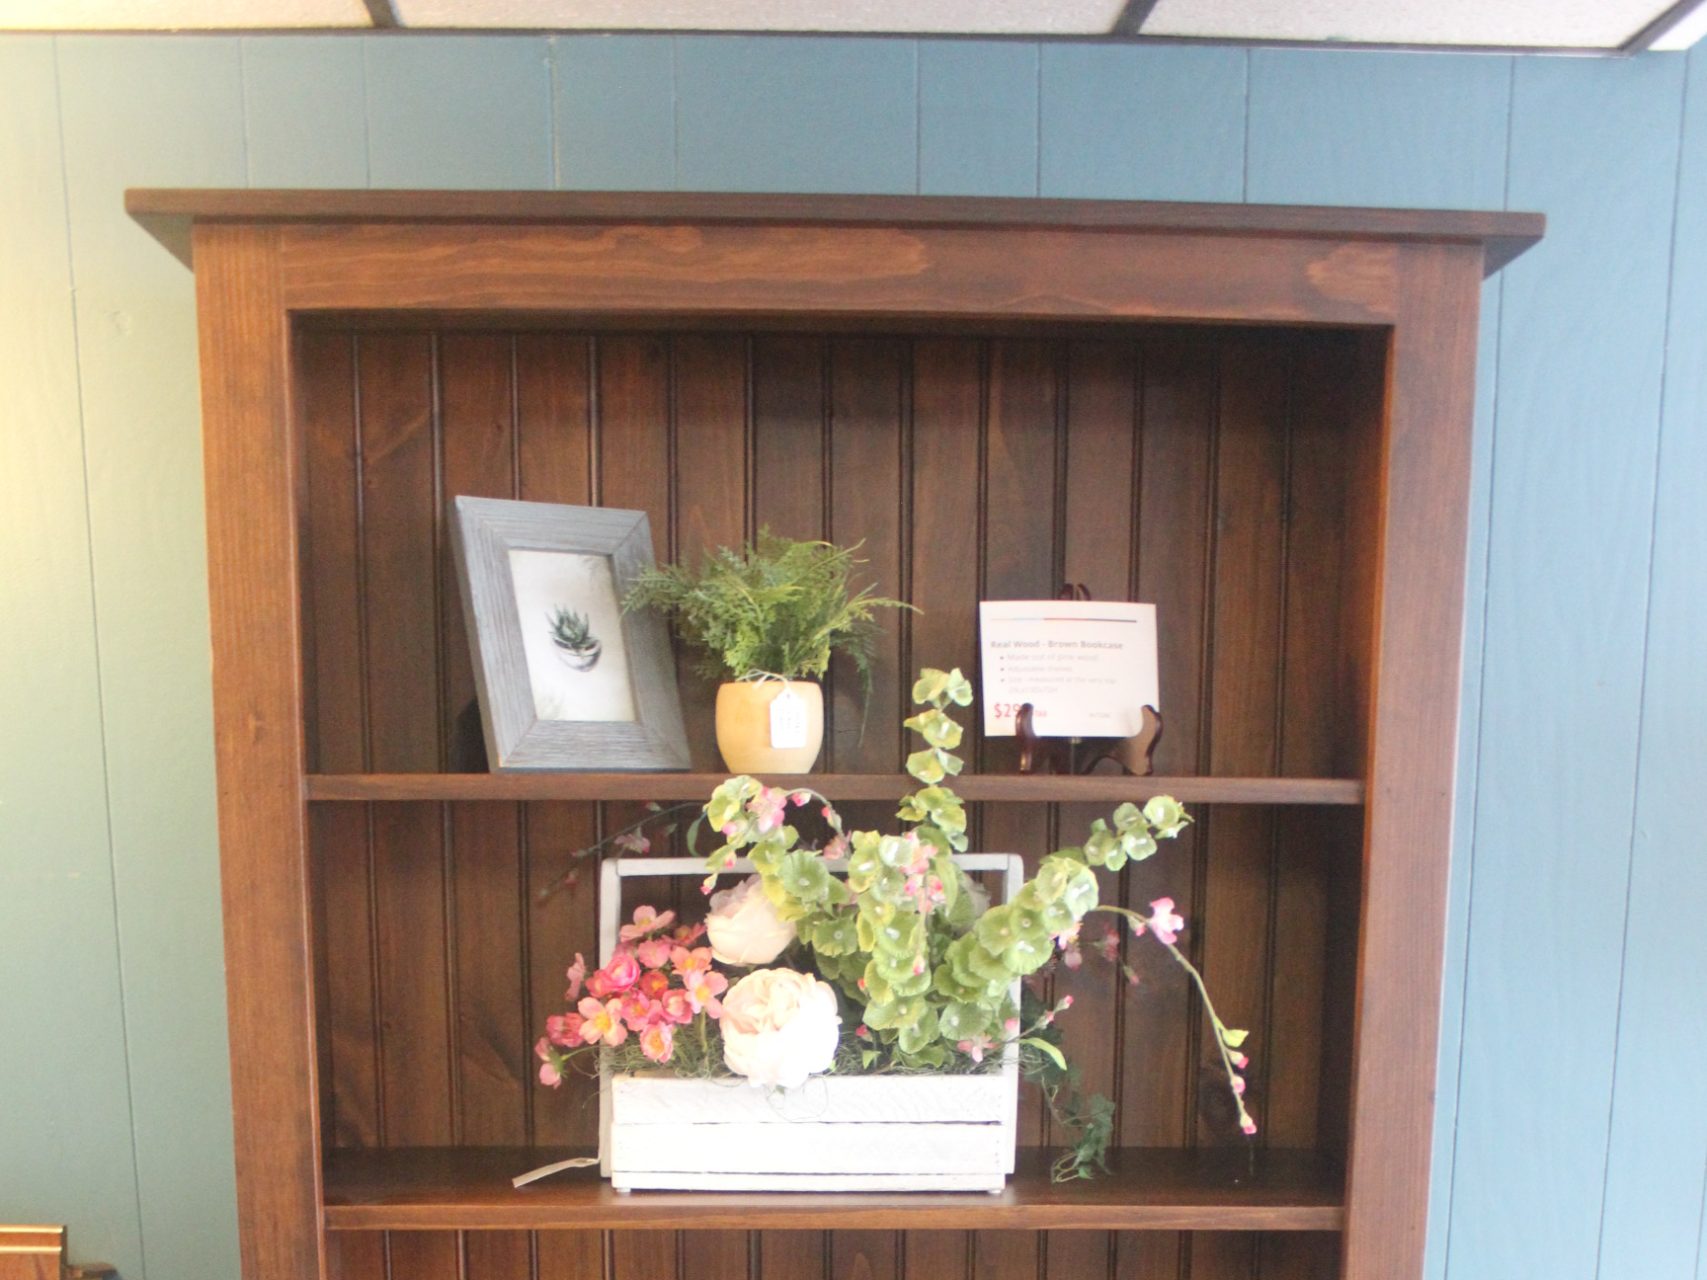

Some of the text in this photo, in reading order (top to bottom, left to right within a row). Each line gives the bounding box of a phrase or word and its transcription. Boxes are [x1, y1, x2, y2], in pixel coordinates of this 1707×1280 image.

[991, 640, 1011, 648] Real
[1014, 640, 1040, 648] Wood
[1048, 640, 1078, 648] Brown
[1081, 640, 1123, 650] Bookcase
